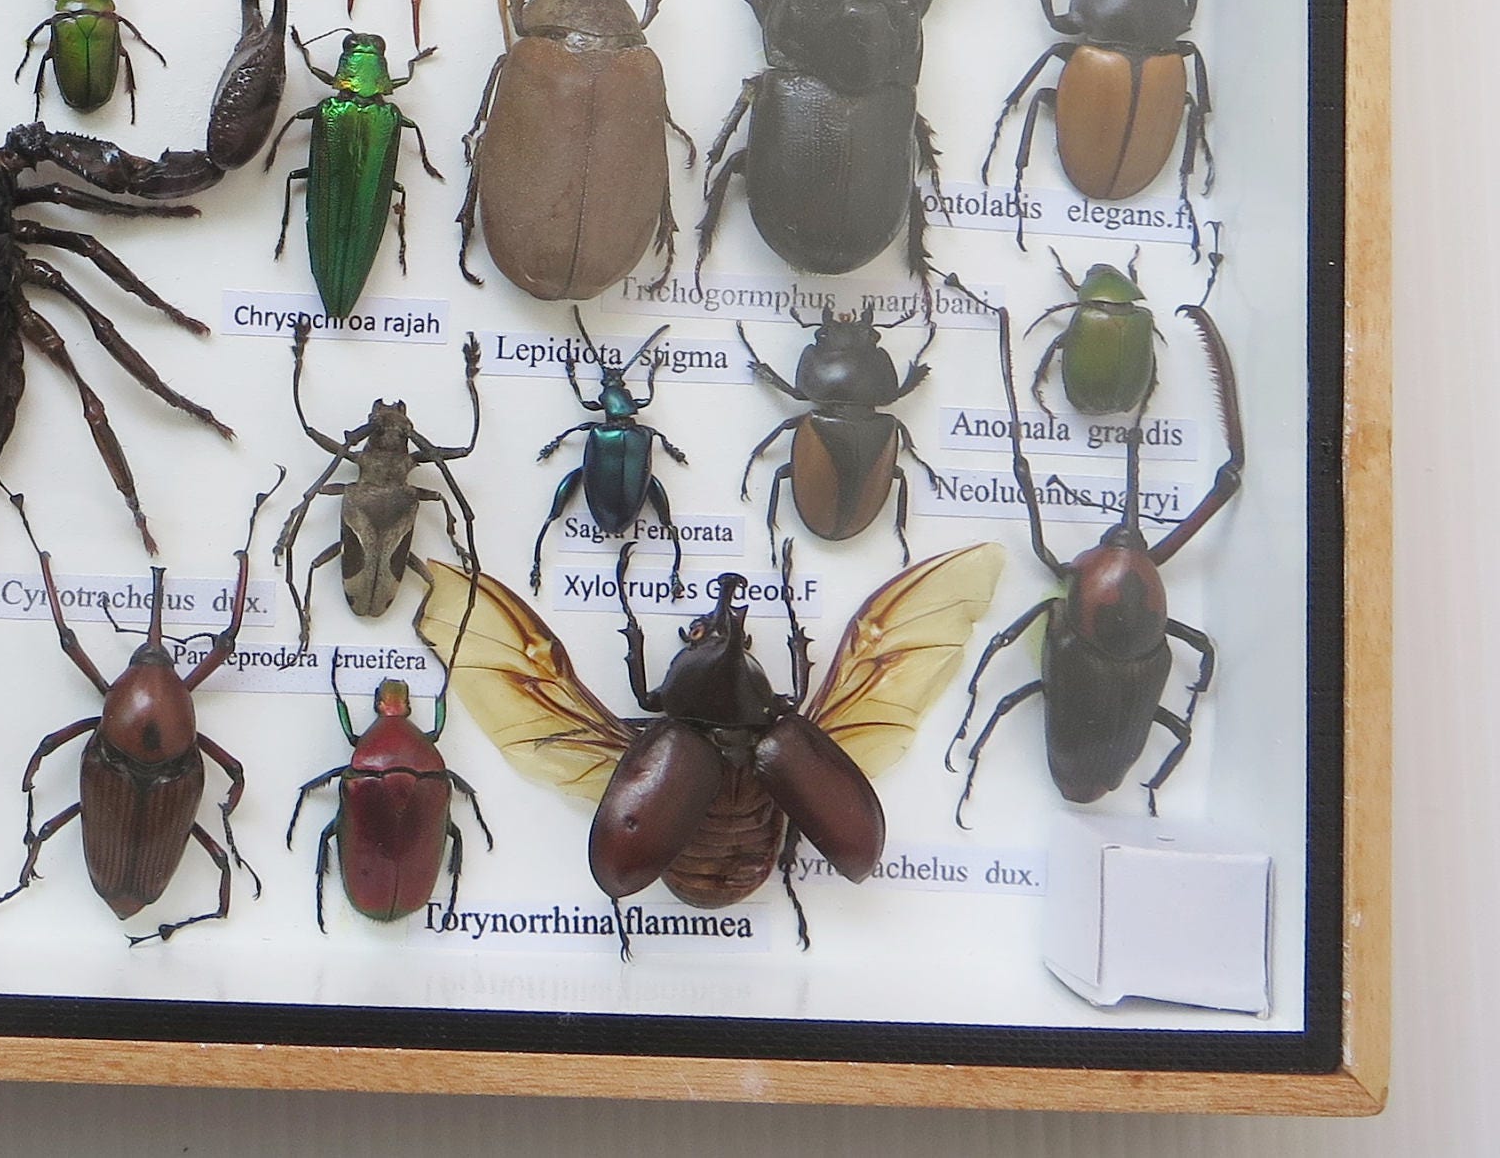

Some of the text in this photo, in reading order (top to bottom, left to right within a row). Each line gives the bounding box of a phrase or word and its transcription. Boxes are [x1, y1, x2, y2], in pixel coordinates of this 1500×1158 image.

[384, 313, 440, 337] rajah
[495, 335, 728, 373] Lepidiota stigma
[1100, 486, 1181, 517] paryi
[564, 517, 734, 544] Sag Femorata
[1, 579, 195, 612] Cyrotracheus
[706, 577, 818, 603] Gdeon.F
[172, 644, 318, 673] Pareprodera
[985, 860, 1040, 887] dux.
[424, 902, 753, 940] Torynorrhina flammea
